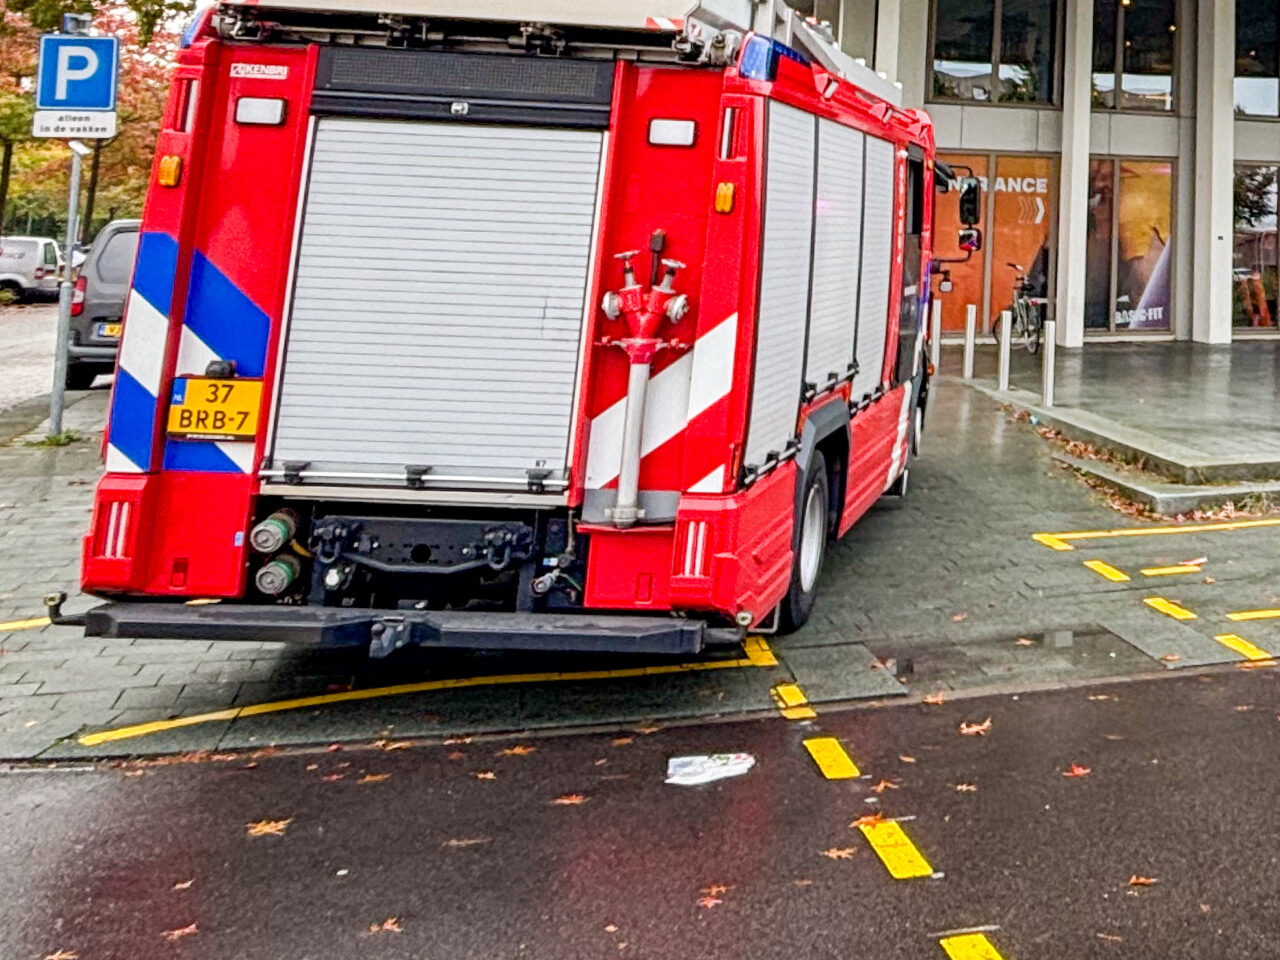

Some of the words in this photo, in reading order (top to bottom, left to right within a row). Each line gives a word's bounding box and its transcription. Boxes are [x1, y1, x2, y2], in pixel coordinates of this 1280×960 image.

[55, 45, 98, 100] P
[69, 125, 107, 133] vakken
[947, 175, 1048, 194] NRANCE
[206, 383, 235, 404] 37
[179, 408, 250, 431] BRB-7
